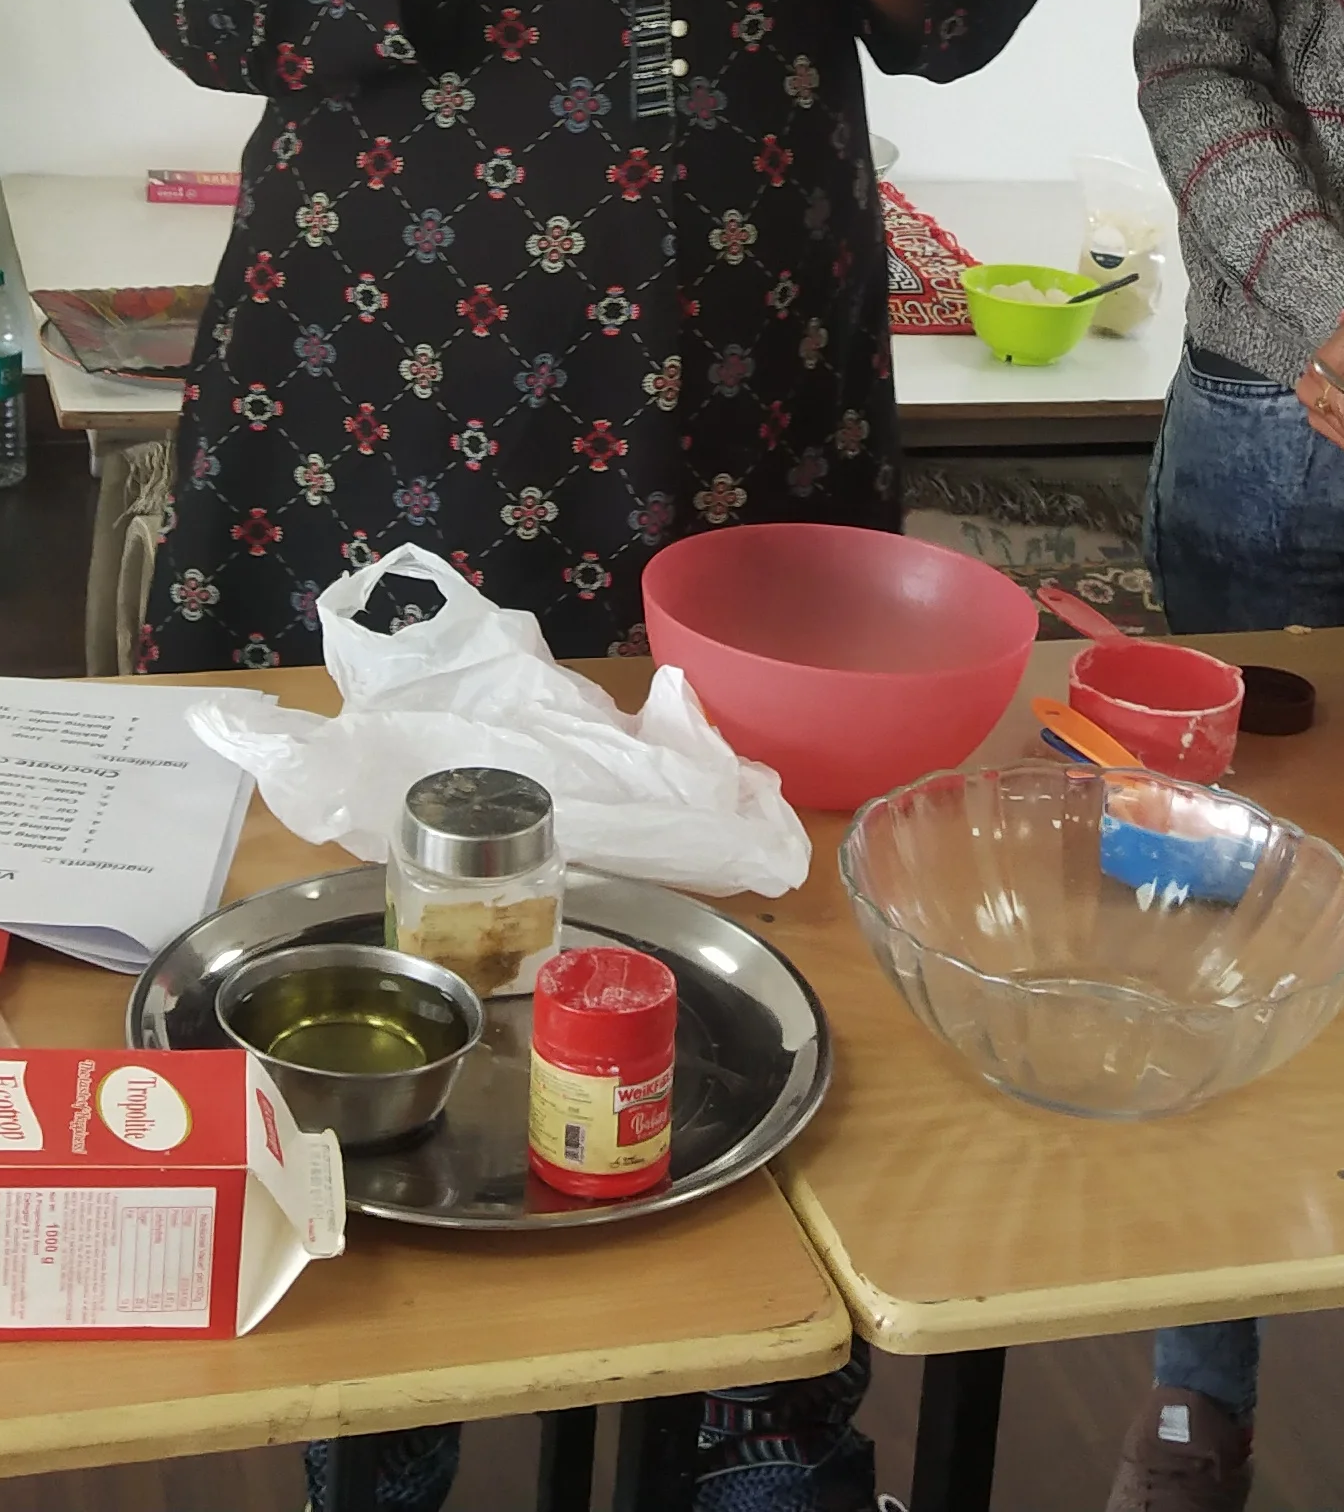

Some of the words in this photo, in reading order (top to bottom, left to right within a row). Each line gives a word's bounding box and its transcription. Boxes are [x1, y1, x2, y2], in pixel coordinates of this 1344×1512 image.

[14, 831, 67, 842] Baking
[117, 1077, 157, 1139] Tropolite
[45, 1223, 60, 1253] 1000
[41, 1256, 55, 1265] g
